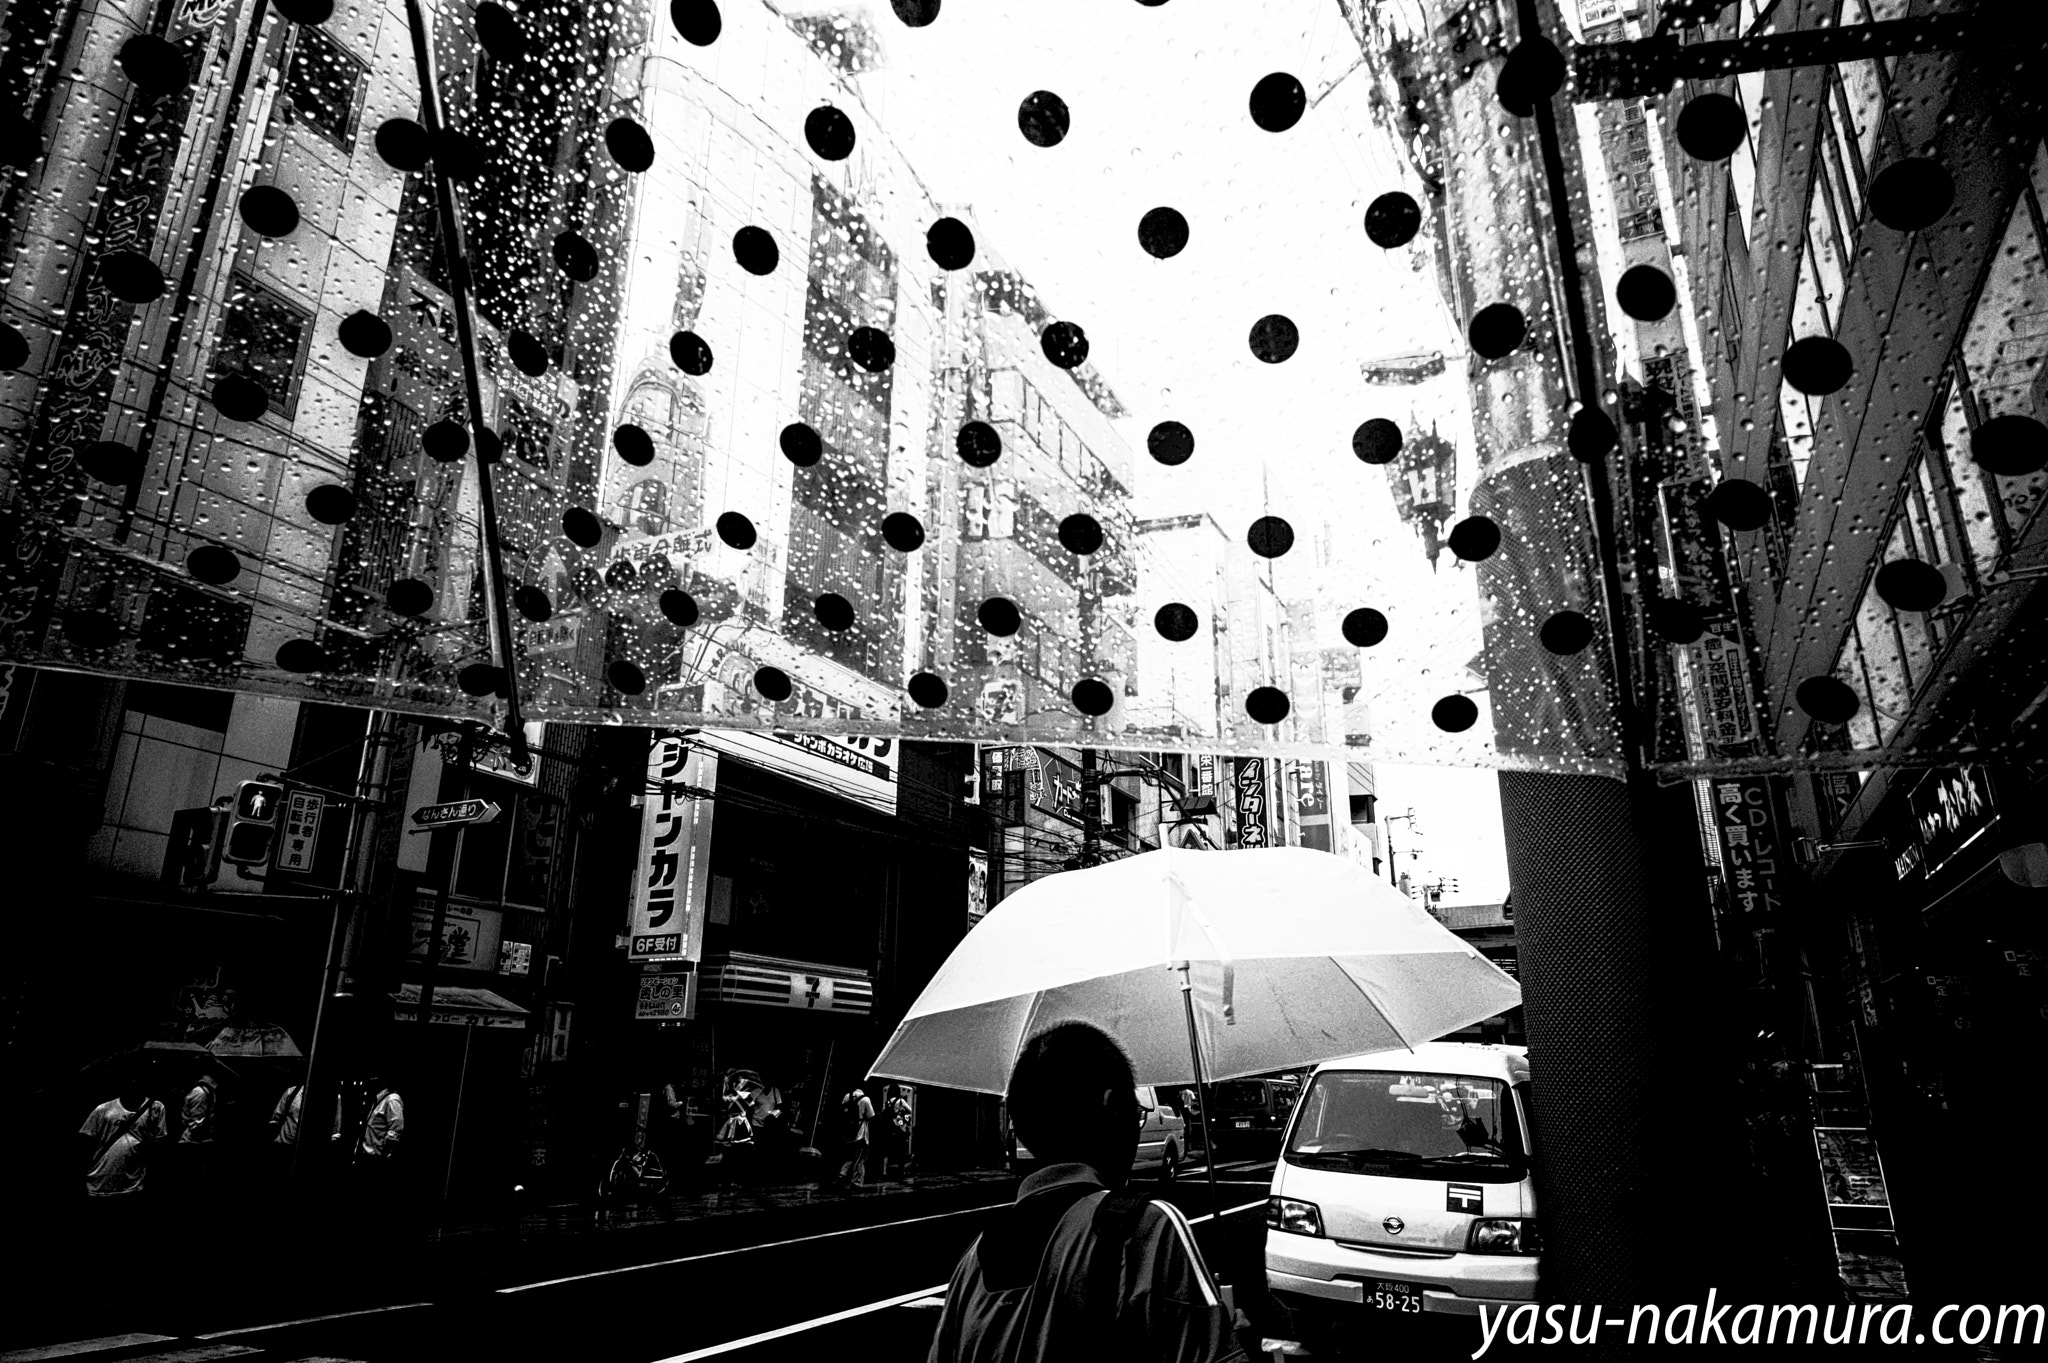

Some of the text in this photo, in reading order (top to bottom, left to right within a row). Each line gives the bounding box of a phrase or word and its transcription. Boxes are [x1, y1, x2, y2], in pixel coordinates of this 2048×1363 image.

[287, 796, 306, 836] 自転車
[301, 799, 320, 838] 歩行者
[422, 803, 478, 821] なんさん通り
[646, 738, 689, 928] ジャンカラ
[288, 839, 305, 867] 専用
[1717, 783, 1758, 912] 高く買います
[636, 933, 677, 954] 6F受付
[465, 1014, 513, 1026] カレー
[1366, 1291, 1420, 1313] あ 58-25
